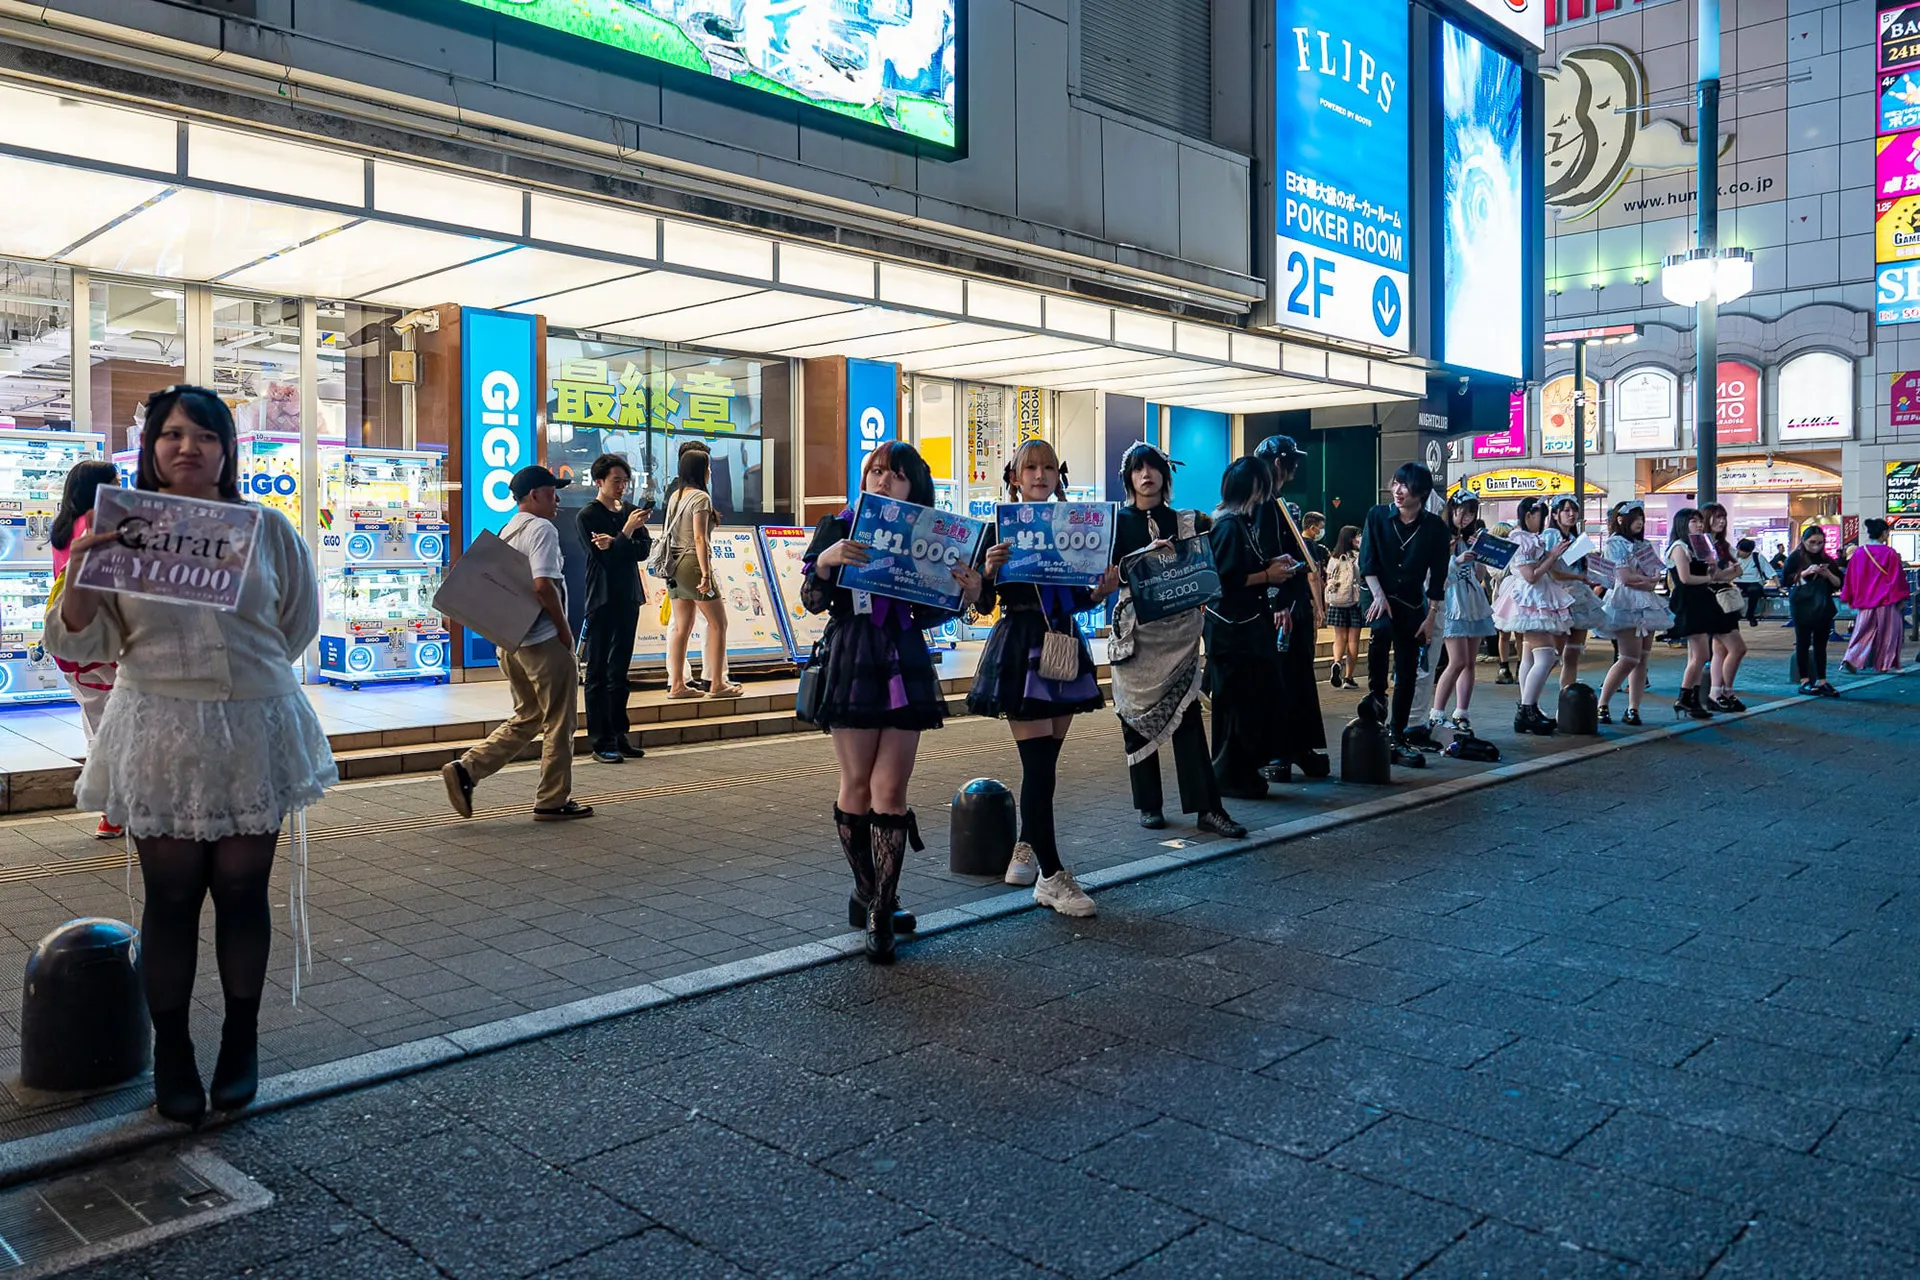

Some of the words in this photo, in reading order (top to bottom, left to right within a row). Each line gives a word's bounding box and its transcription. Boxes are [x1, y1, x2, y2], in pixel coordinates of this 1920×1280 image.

[1293, 27, 1396, 114] FLIPS
[1882, 76, 1896, 87] 4F
[1319, 97, 1346, 118] POWERED
[1346, 109, 1355, 120] BY
[1285, 199, 1348, 244] POKER
[1353, 222, 1402, 262] ROOM
[1287, 250, 1336, 319] 2F
[552, 358, 736, 440] 最終章
[1020, 390, 1030, 442] EXCHA
[1031, 388, 1041, 435] MONEY
[1418, 412, 1448, 429] NIGHTCLUB
[481, 369, 520, 513] GiGO
[1544, 440, 1593, 450] ボウリグ
[237, 473, 296, 495] iGO
[1486, 477, 1508, 489] GAME
[1511, 476, 1535, 488] PANIC
[969, 500, 997, 516] GiG
[324, 535, 341, 546] GiGO
